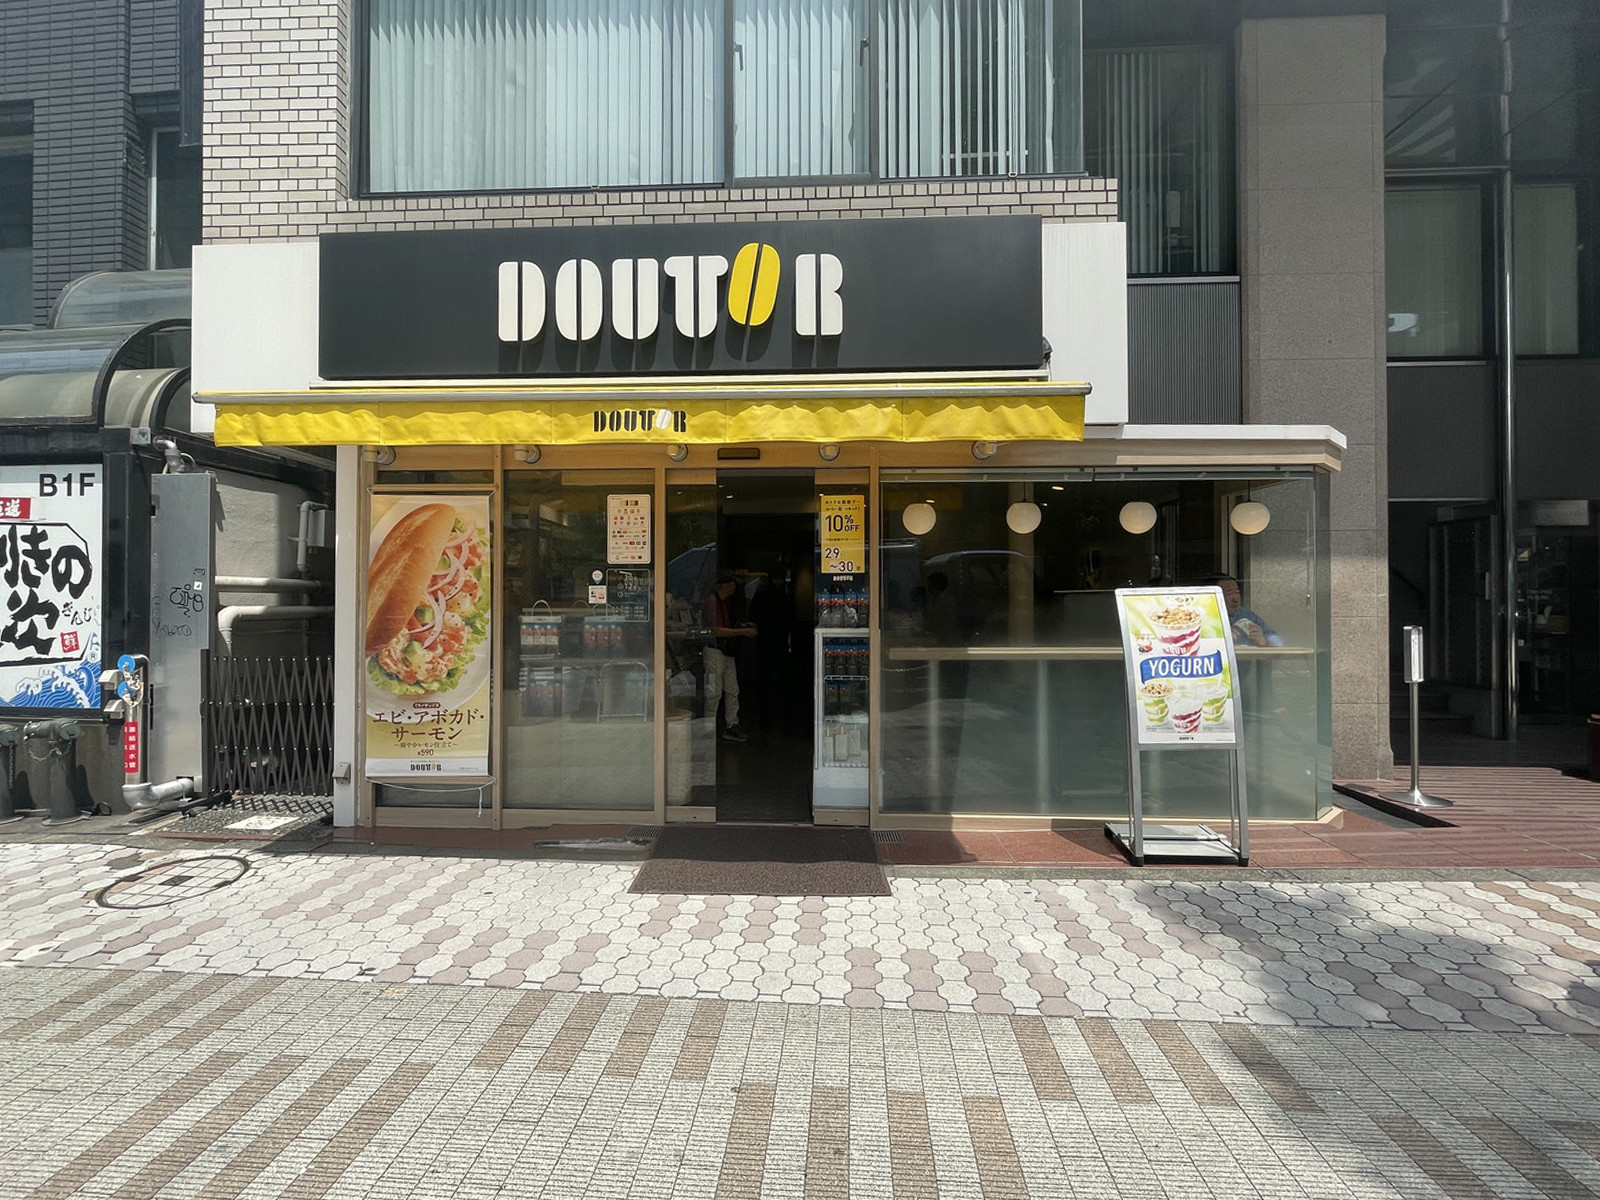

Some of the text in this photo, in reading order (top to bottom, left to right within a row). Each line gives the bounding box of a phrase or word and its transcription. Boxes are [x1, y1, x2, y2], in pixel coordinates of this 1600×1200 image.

[498, 242, 844, 342] DOUTOR
[593, 408, 687, 433] DOUTOR
[39, 472, 96, 497] B1F
[844, 524, 860, 532] OFF
[825, 547, 840, 559] 29
[0, 588, 60, 656] 次
[62, 601, 92, 626] ぎんじ
[1149, 657, 1215, 677] YOGURN
[372, 708, 485, 726] エビ・アボカド・
[391, 726, 463, 742] サーモン
[410, 763, 442, 772] DOUTOR
